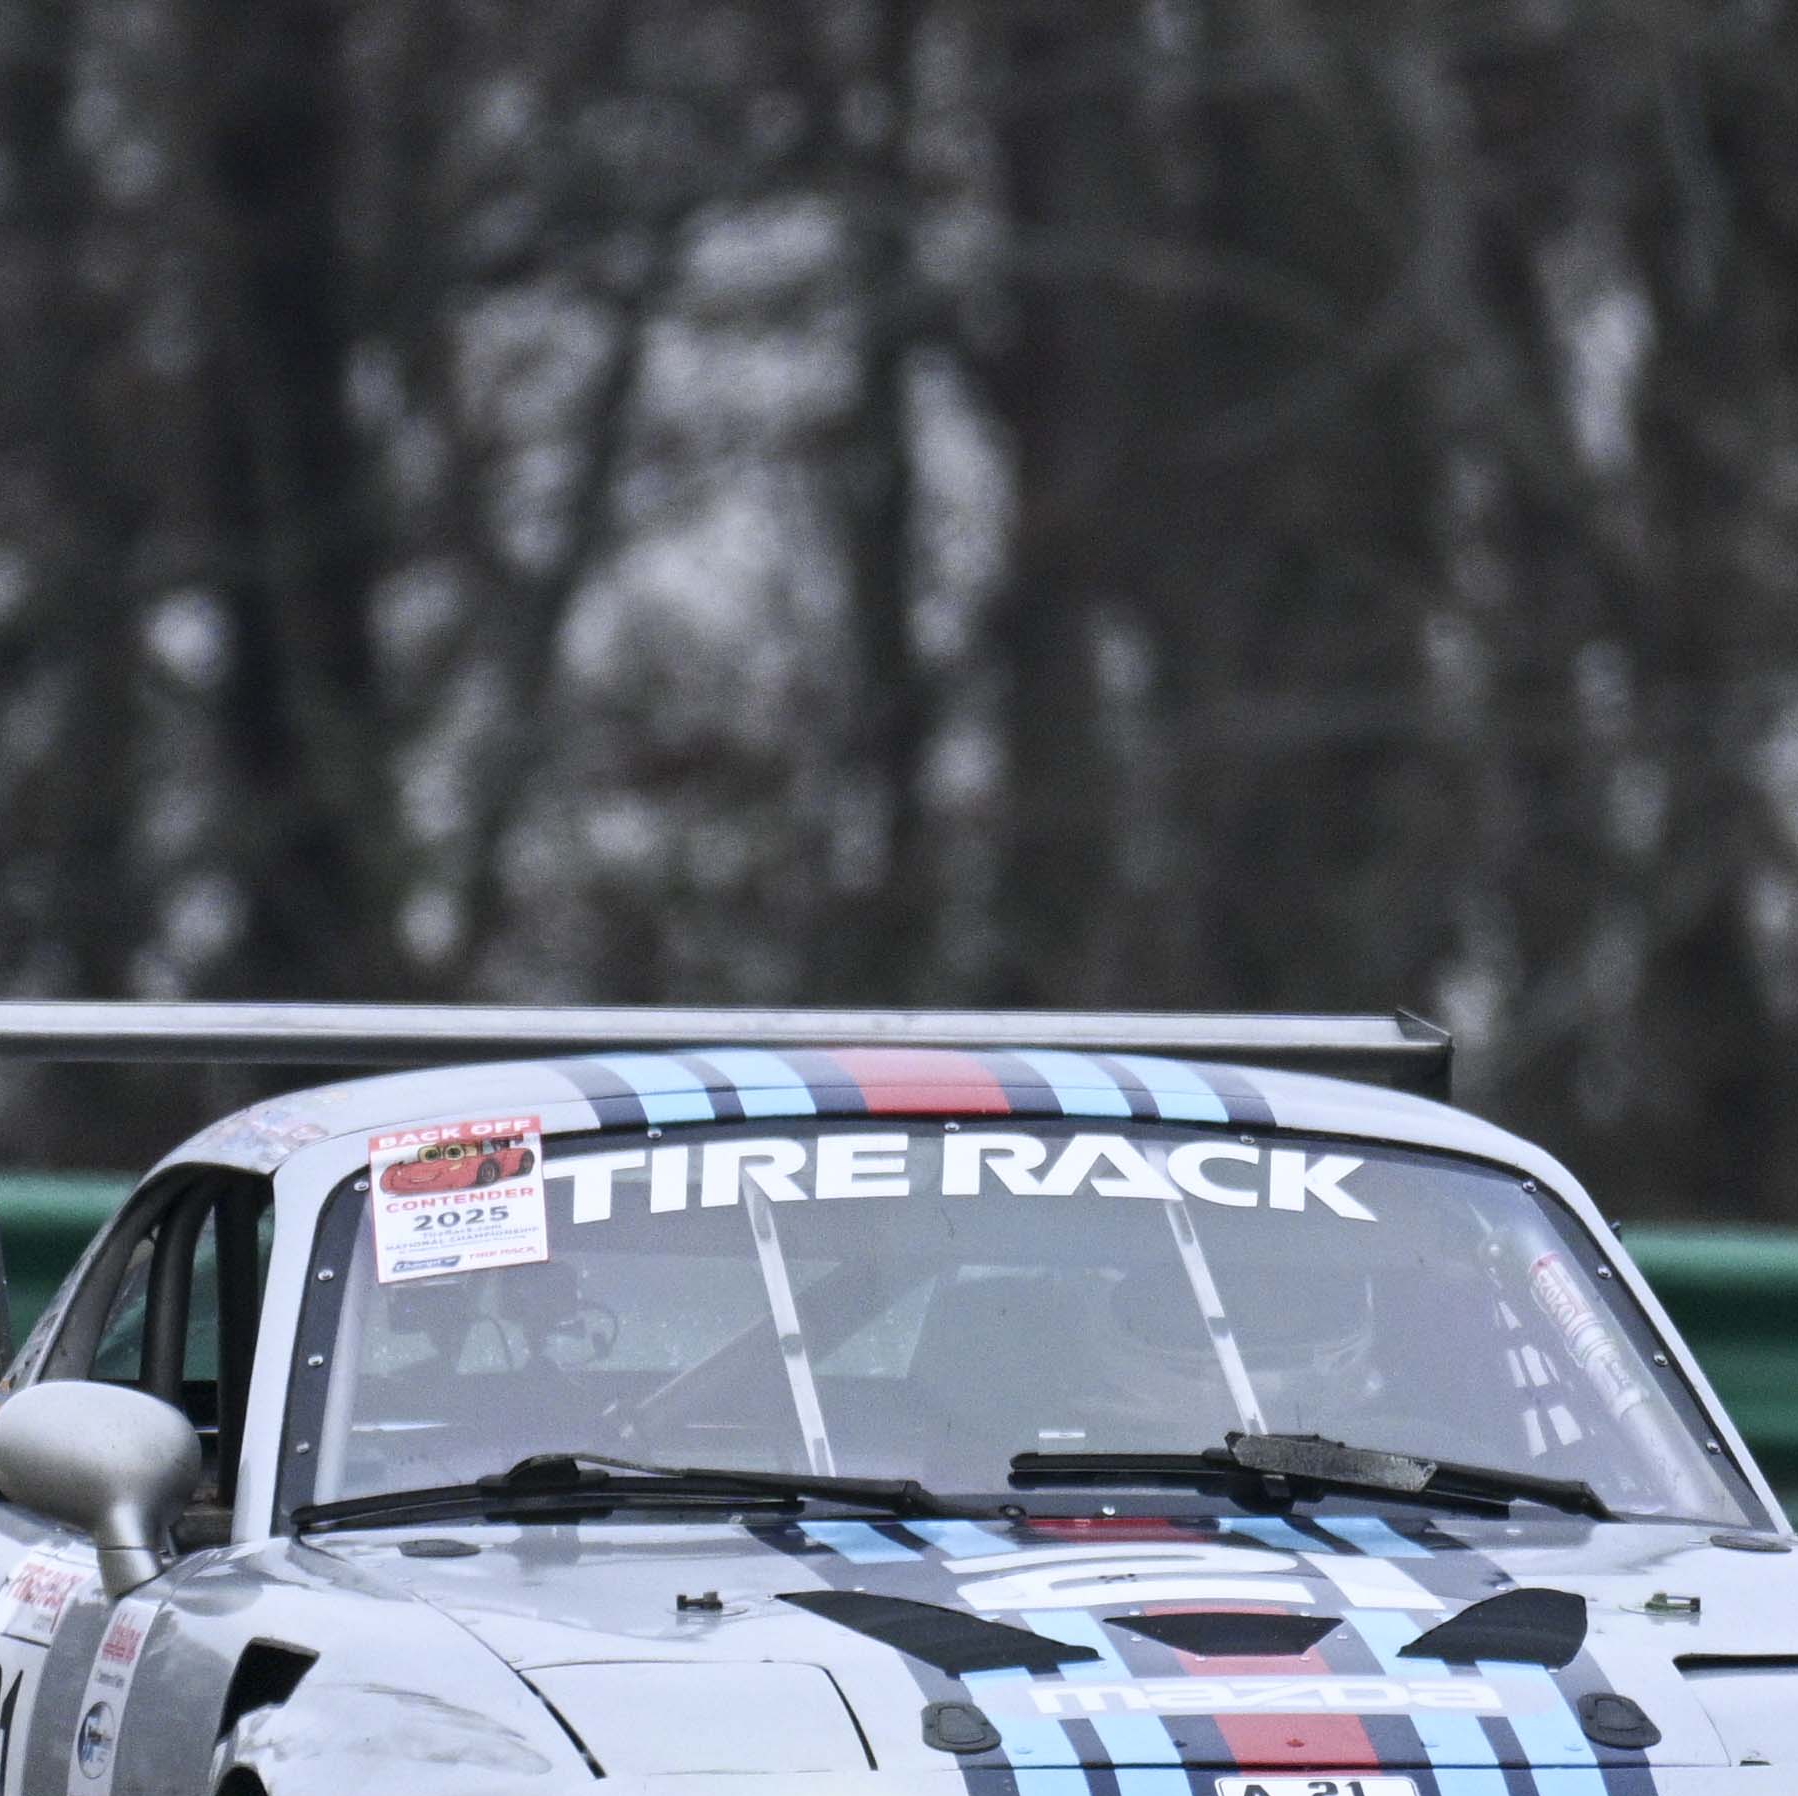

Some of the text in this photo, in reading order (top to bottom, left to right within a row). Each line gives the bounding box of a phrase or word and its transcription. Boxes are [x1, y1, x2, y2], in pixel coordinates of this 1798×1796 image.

[378, 1118, 533, 1149] BACK OFF
[543, 1132, 1378, 1224] TIRE RACK
[385, 1187, 535, 1215] CONTENDER
[412, 1205, 510, 1232] 2025
